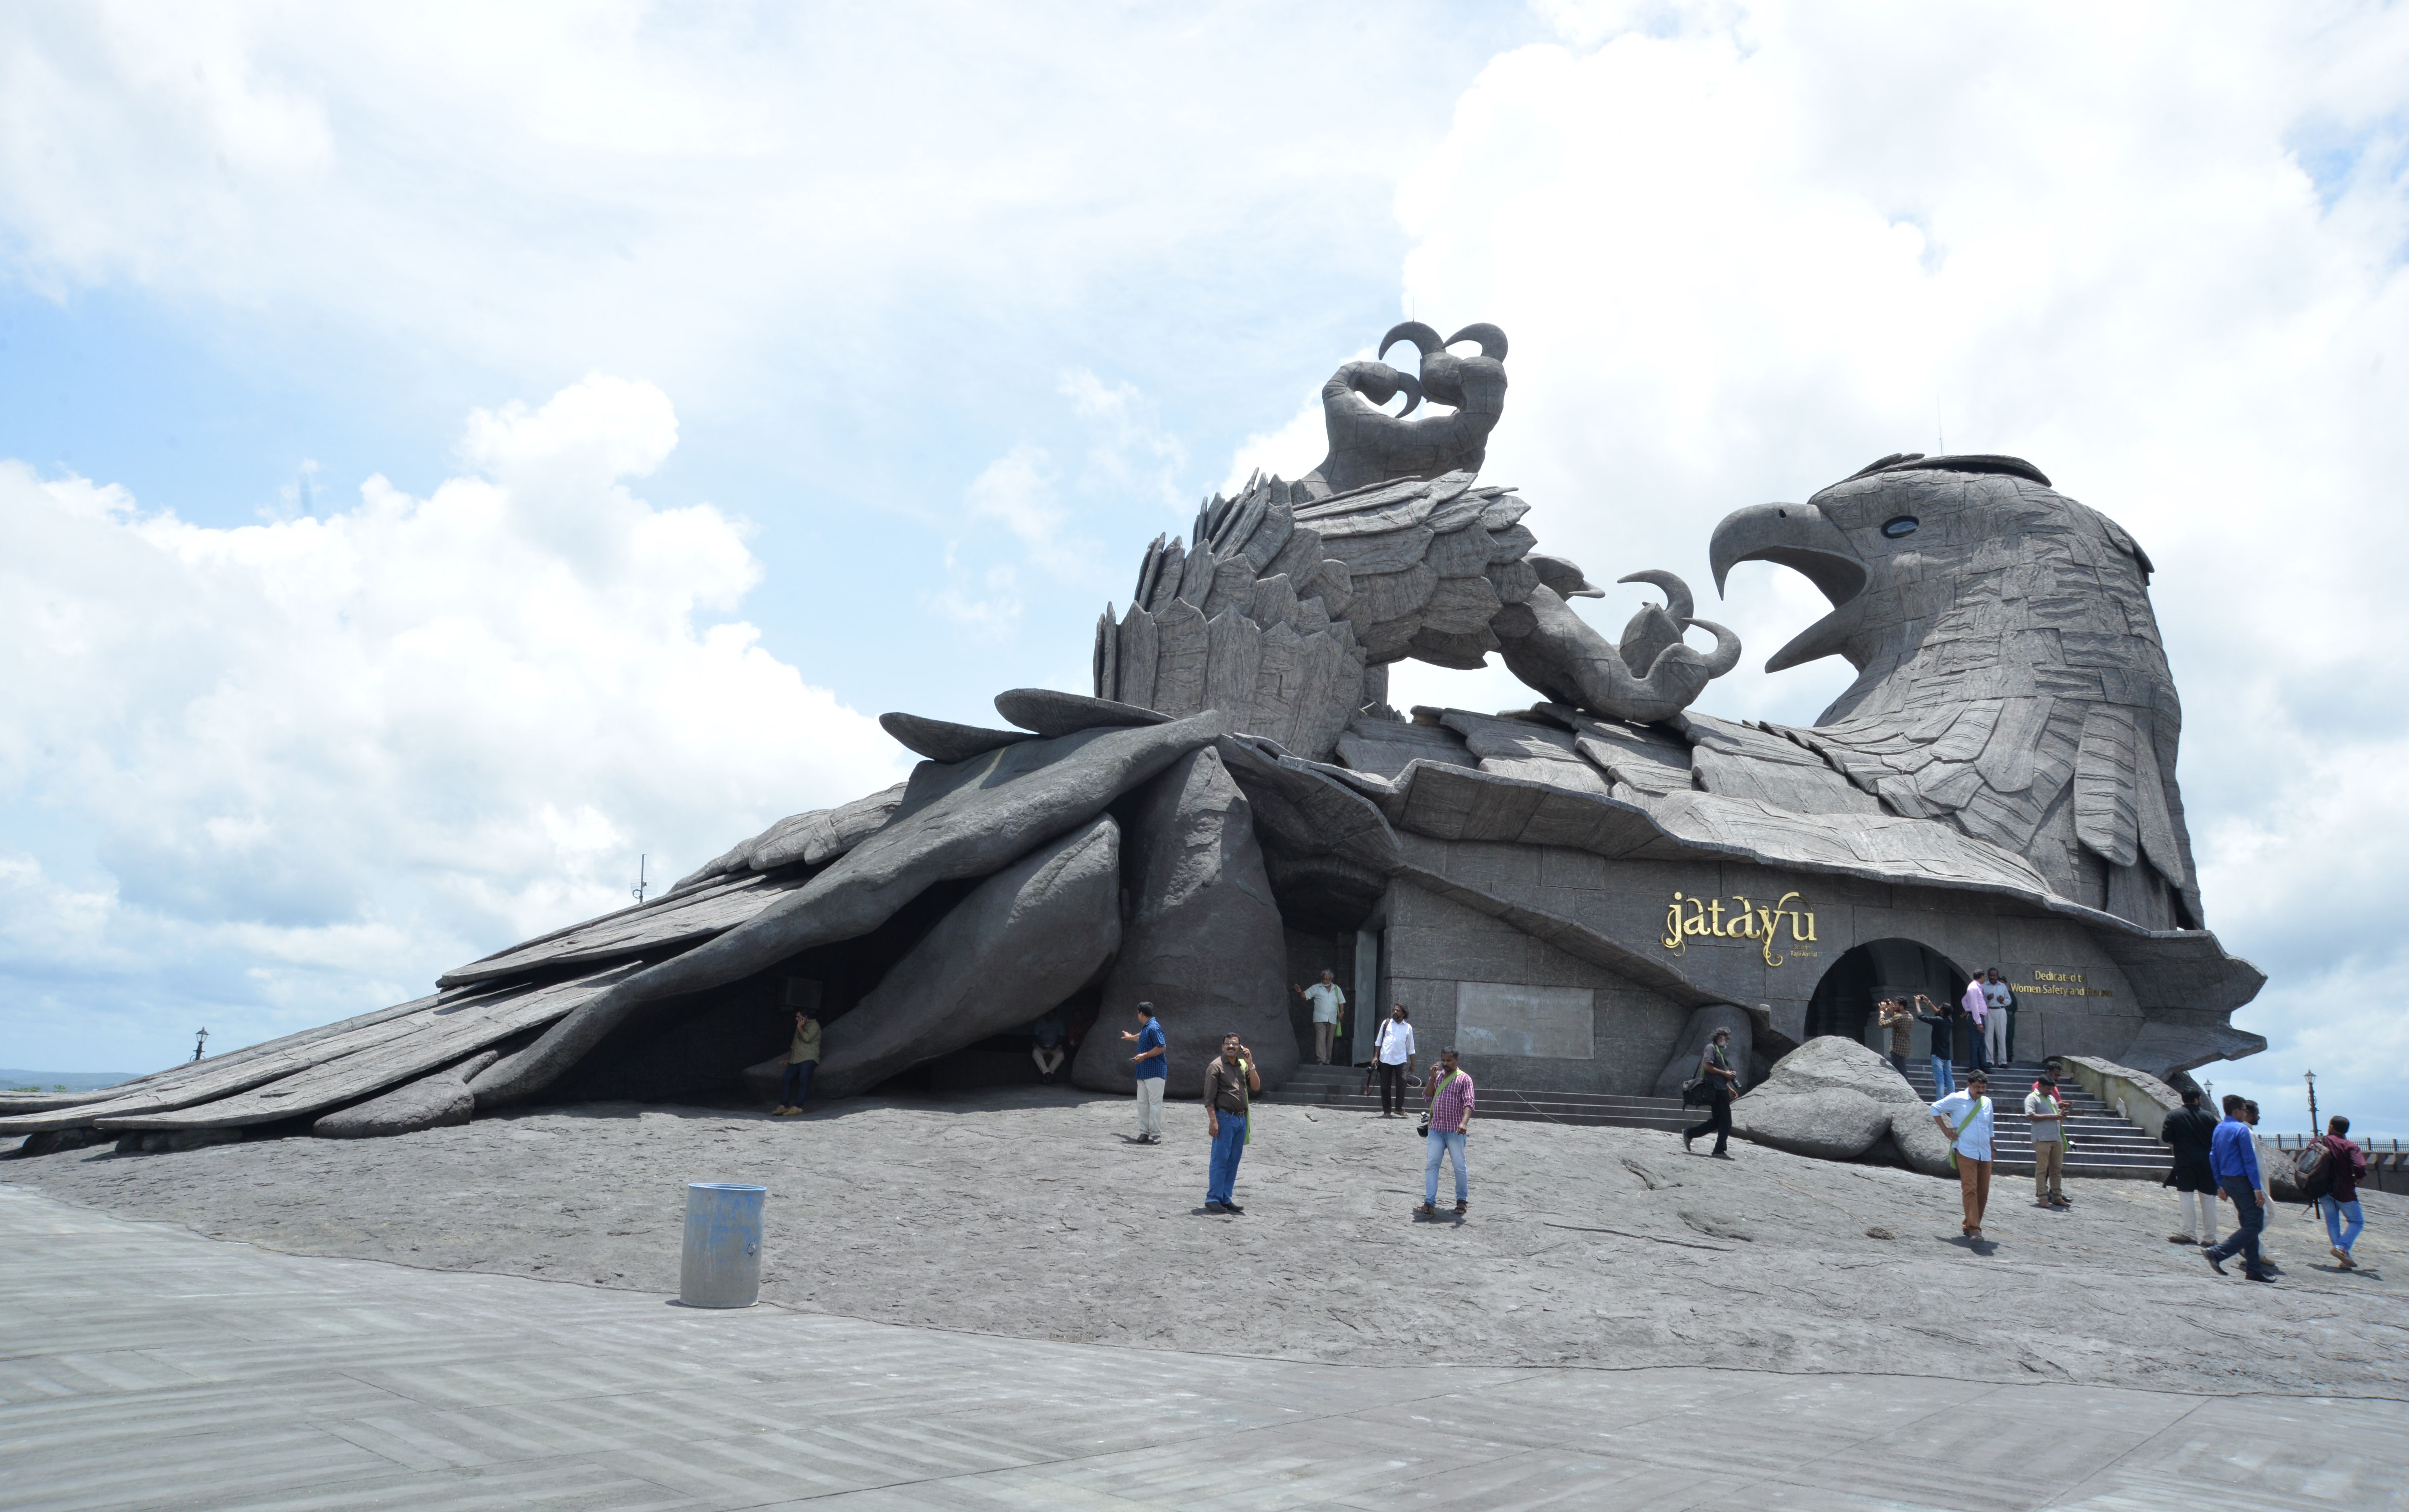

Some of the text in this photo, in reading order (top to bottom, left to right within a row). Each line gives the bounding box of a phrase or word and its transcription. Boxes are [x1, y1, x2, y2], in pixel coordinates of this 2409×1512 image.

[1661, 892, 1818, 967] jatayu
[2035, 971, 2086, 982] Dedicated to
[2011, 983, 2113, 997] Women Safety and Hon
